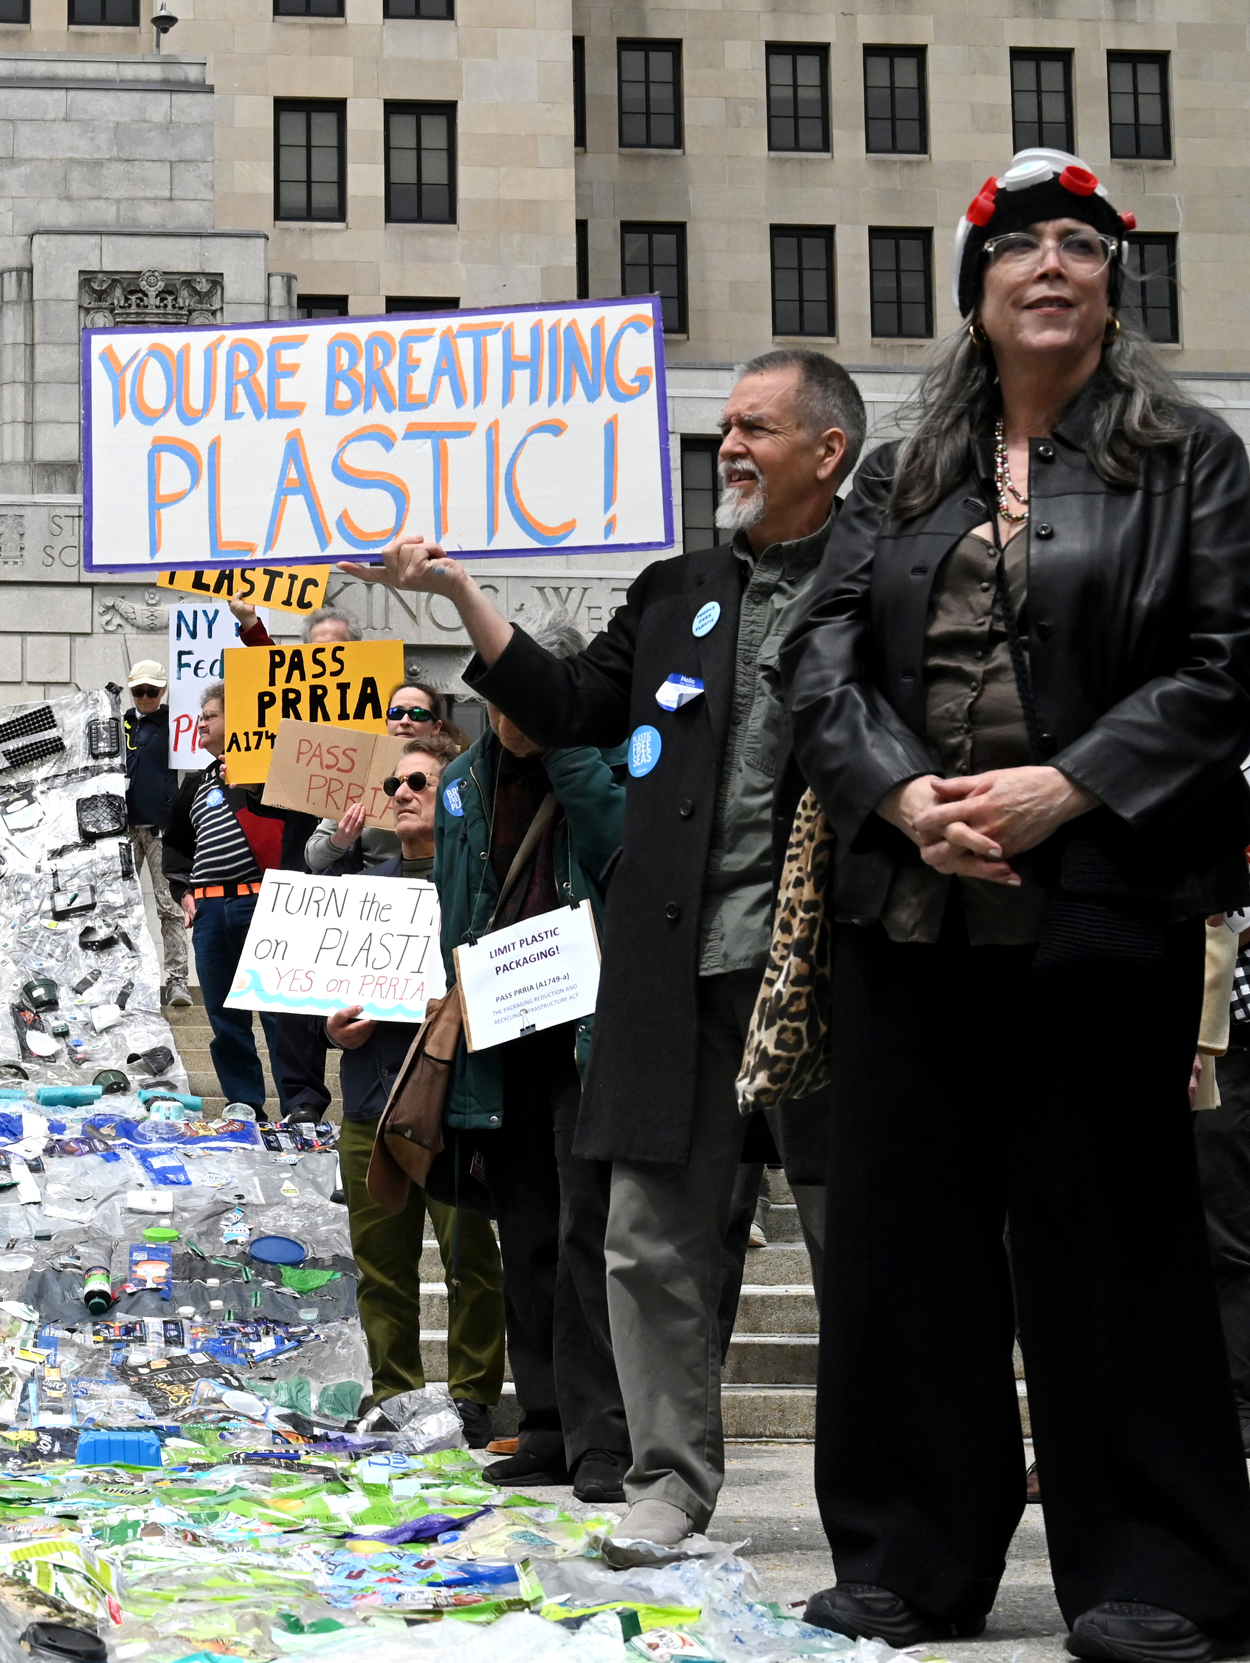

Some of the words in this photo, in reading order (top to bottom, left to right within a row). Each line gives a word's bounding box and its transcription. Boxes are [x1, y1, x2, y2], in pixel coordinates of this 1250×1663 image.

[325, 313, 654, 417] BREATHING
[147, 413, 619, 561] PLASTIC!
[176, 609, 220, 641] NY
[268, 646, 345, 687] PASS
[257, 677, 382, 727] PRRIA
[296, 739, 357, 773] PASS
[632, 752, 652, 768] SEAS
[633, 740, 652, 756] FREE
[269, 881, 349, 918] TURN
[359, 892, 393, 922] the
[254, 938, 289, 960] on
[314, 927, 431, 973] PLASTI
[489, 942, 517, 959] LIMIT
[519, 927, 561, 949] PLASTIC
[494, 945, 561, 976] PACKAGING!
[275, 966, 316, 992] YES
[326, 979, 350, 994] on
[495, 992, 513, 1003] PASS
[514, 985, 534, 996] PRRIA
[503, 998, 533, 1012] PACKAGING
[534, 987, 565, 1002] REDUCTION
[565, 983, 578, 992] AND
